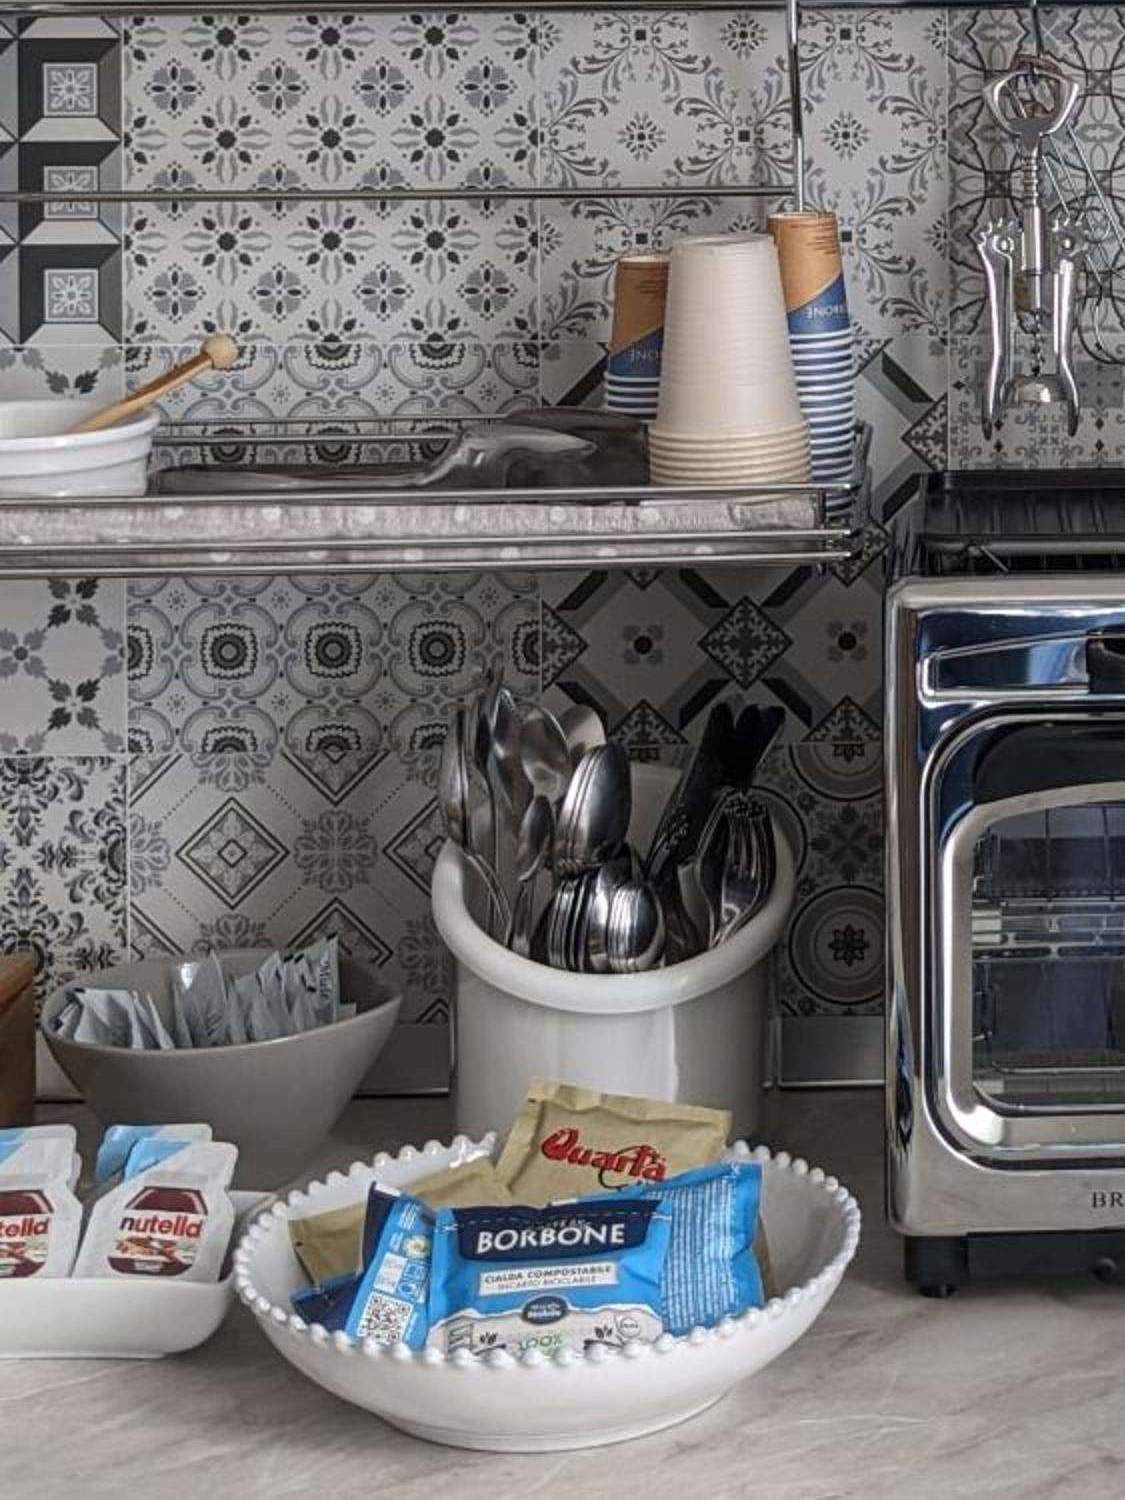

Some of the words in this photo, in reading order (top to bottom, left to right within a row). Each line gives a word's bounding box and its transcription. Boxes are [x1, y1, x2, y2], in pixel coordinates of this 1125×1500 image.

[0, 1217, 50, 1237] tella
[119, 1215, 203, 1238] nutella
[475, 1222, 627, 1255] BORBONE
